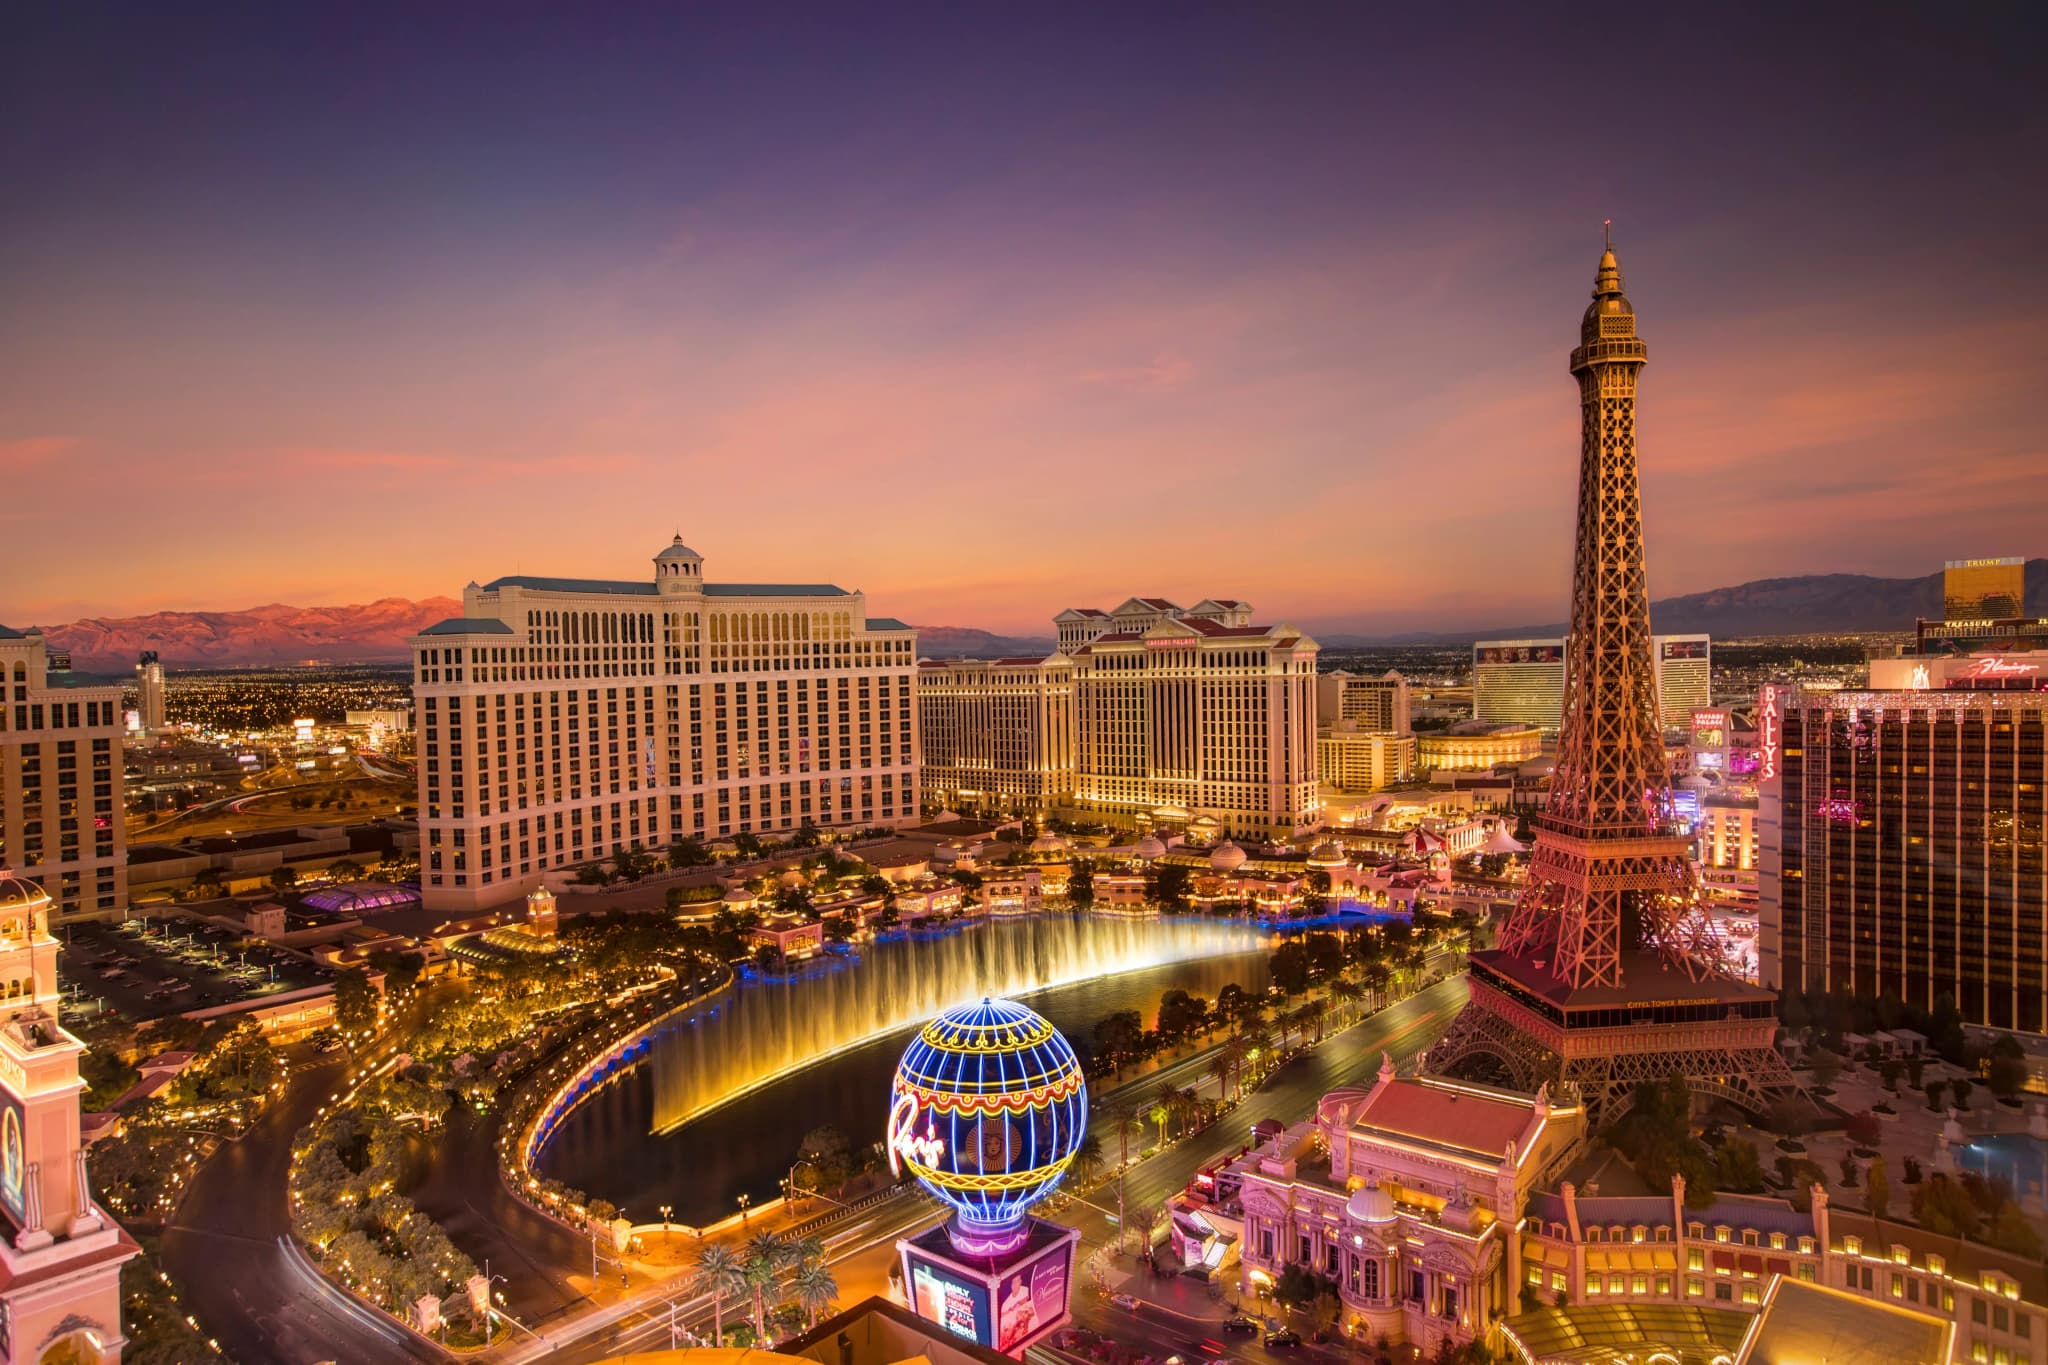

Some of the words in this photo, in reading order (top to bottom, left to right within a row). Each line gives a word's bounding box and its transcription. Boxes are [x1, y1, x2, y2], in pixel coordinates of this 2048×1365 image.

[1967, 560, 2001, 568] TRUMP
[1944, 620, 1994, 628] TREASURE
[1979, 657, 2039, 675] Flamingo
